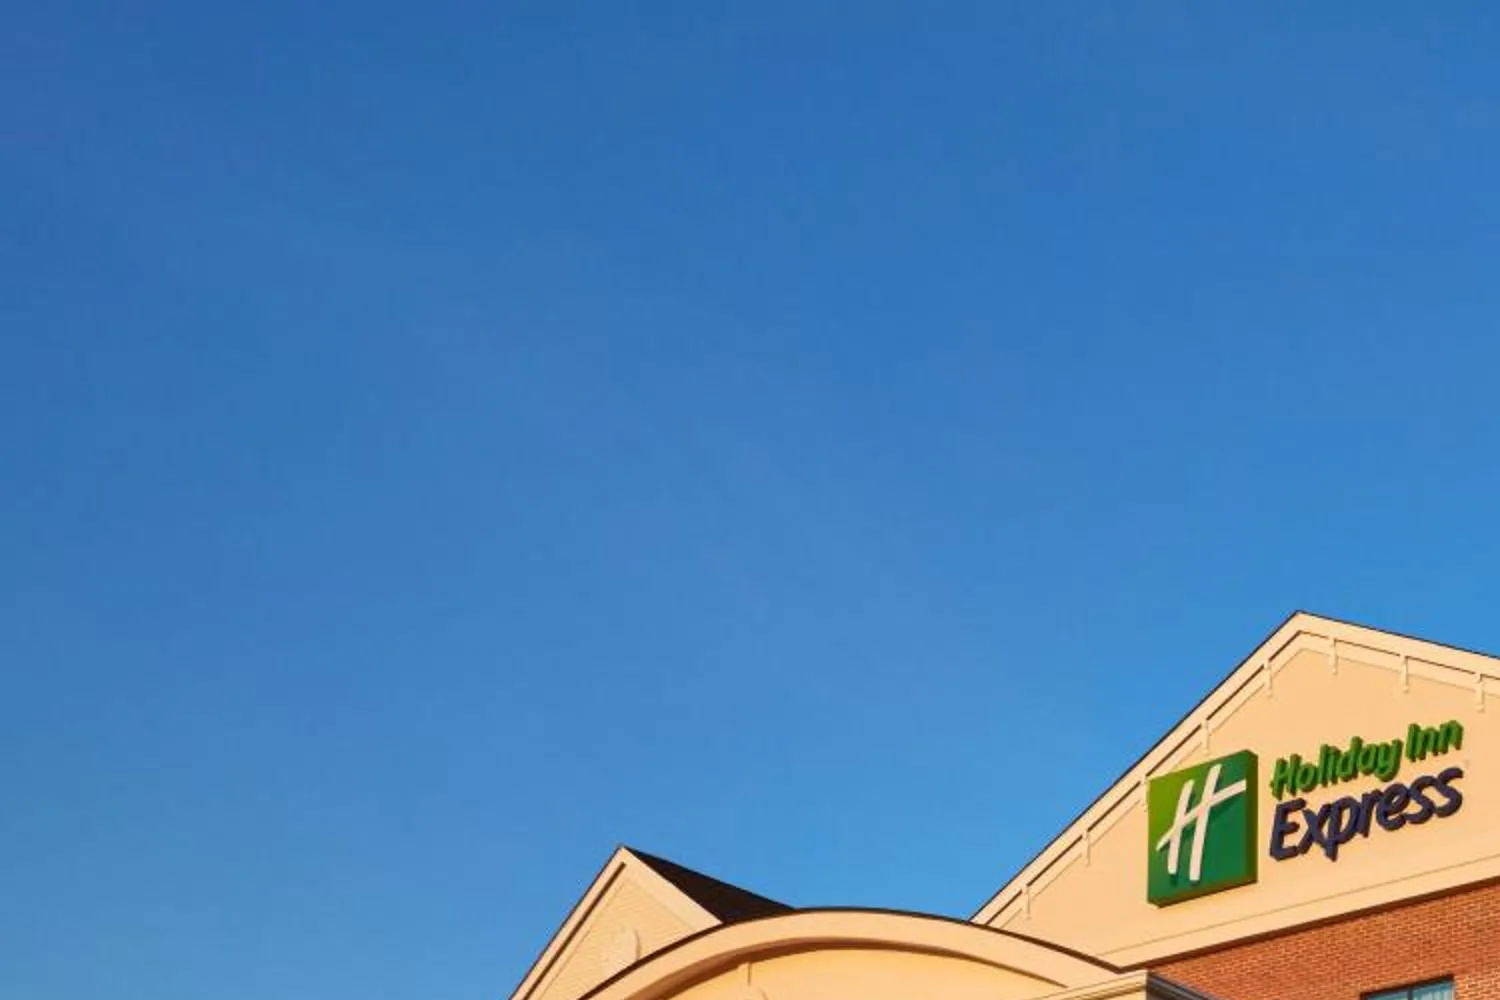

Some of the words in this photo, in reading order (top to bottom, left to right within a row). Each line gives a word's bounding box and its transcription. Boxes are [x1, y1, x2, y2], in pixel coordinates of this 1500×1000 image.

[1270, 736, 1401, 800] Holiday
[1405, 720, 1464, 762] Inn
[1155, 763, 1247, 883] H
[1269, 767, 1464, 862] Express
